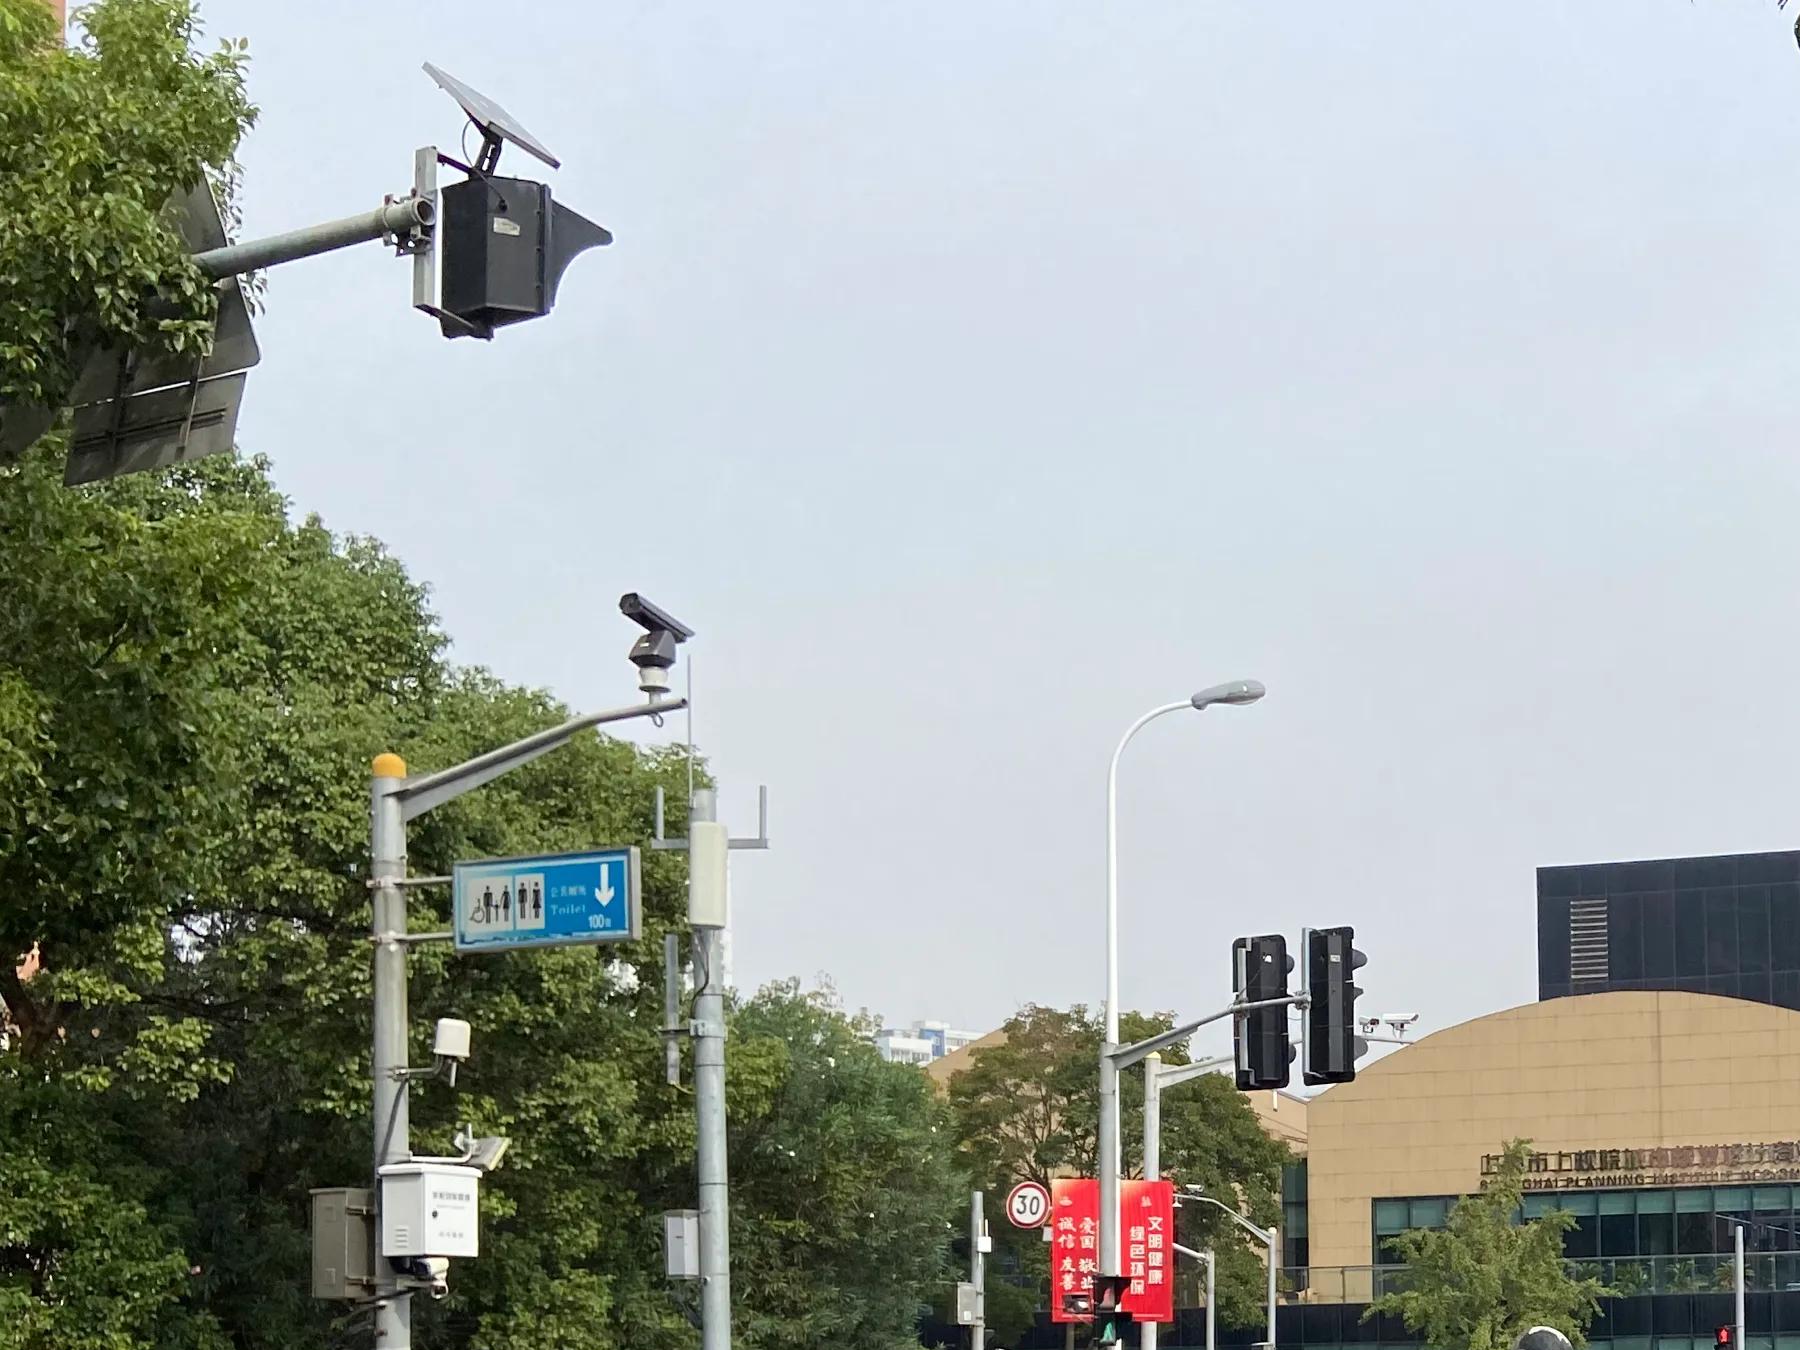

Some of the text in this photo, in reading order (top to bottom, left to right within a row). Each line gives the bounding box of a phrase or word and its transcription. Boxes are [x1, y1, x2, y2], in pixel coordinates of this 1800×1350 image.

[549, 904, 586, 916] Toilet
[1567, 1173, 1645, 1188] PLANNING
[1016, 1195, 1040, 1215] 30
[1129, 1226, 1145, 1294] 绿色环保
[1147, 1216, 1163, 1285] 文明健康
